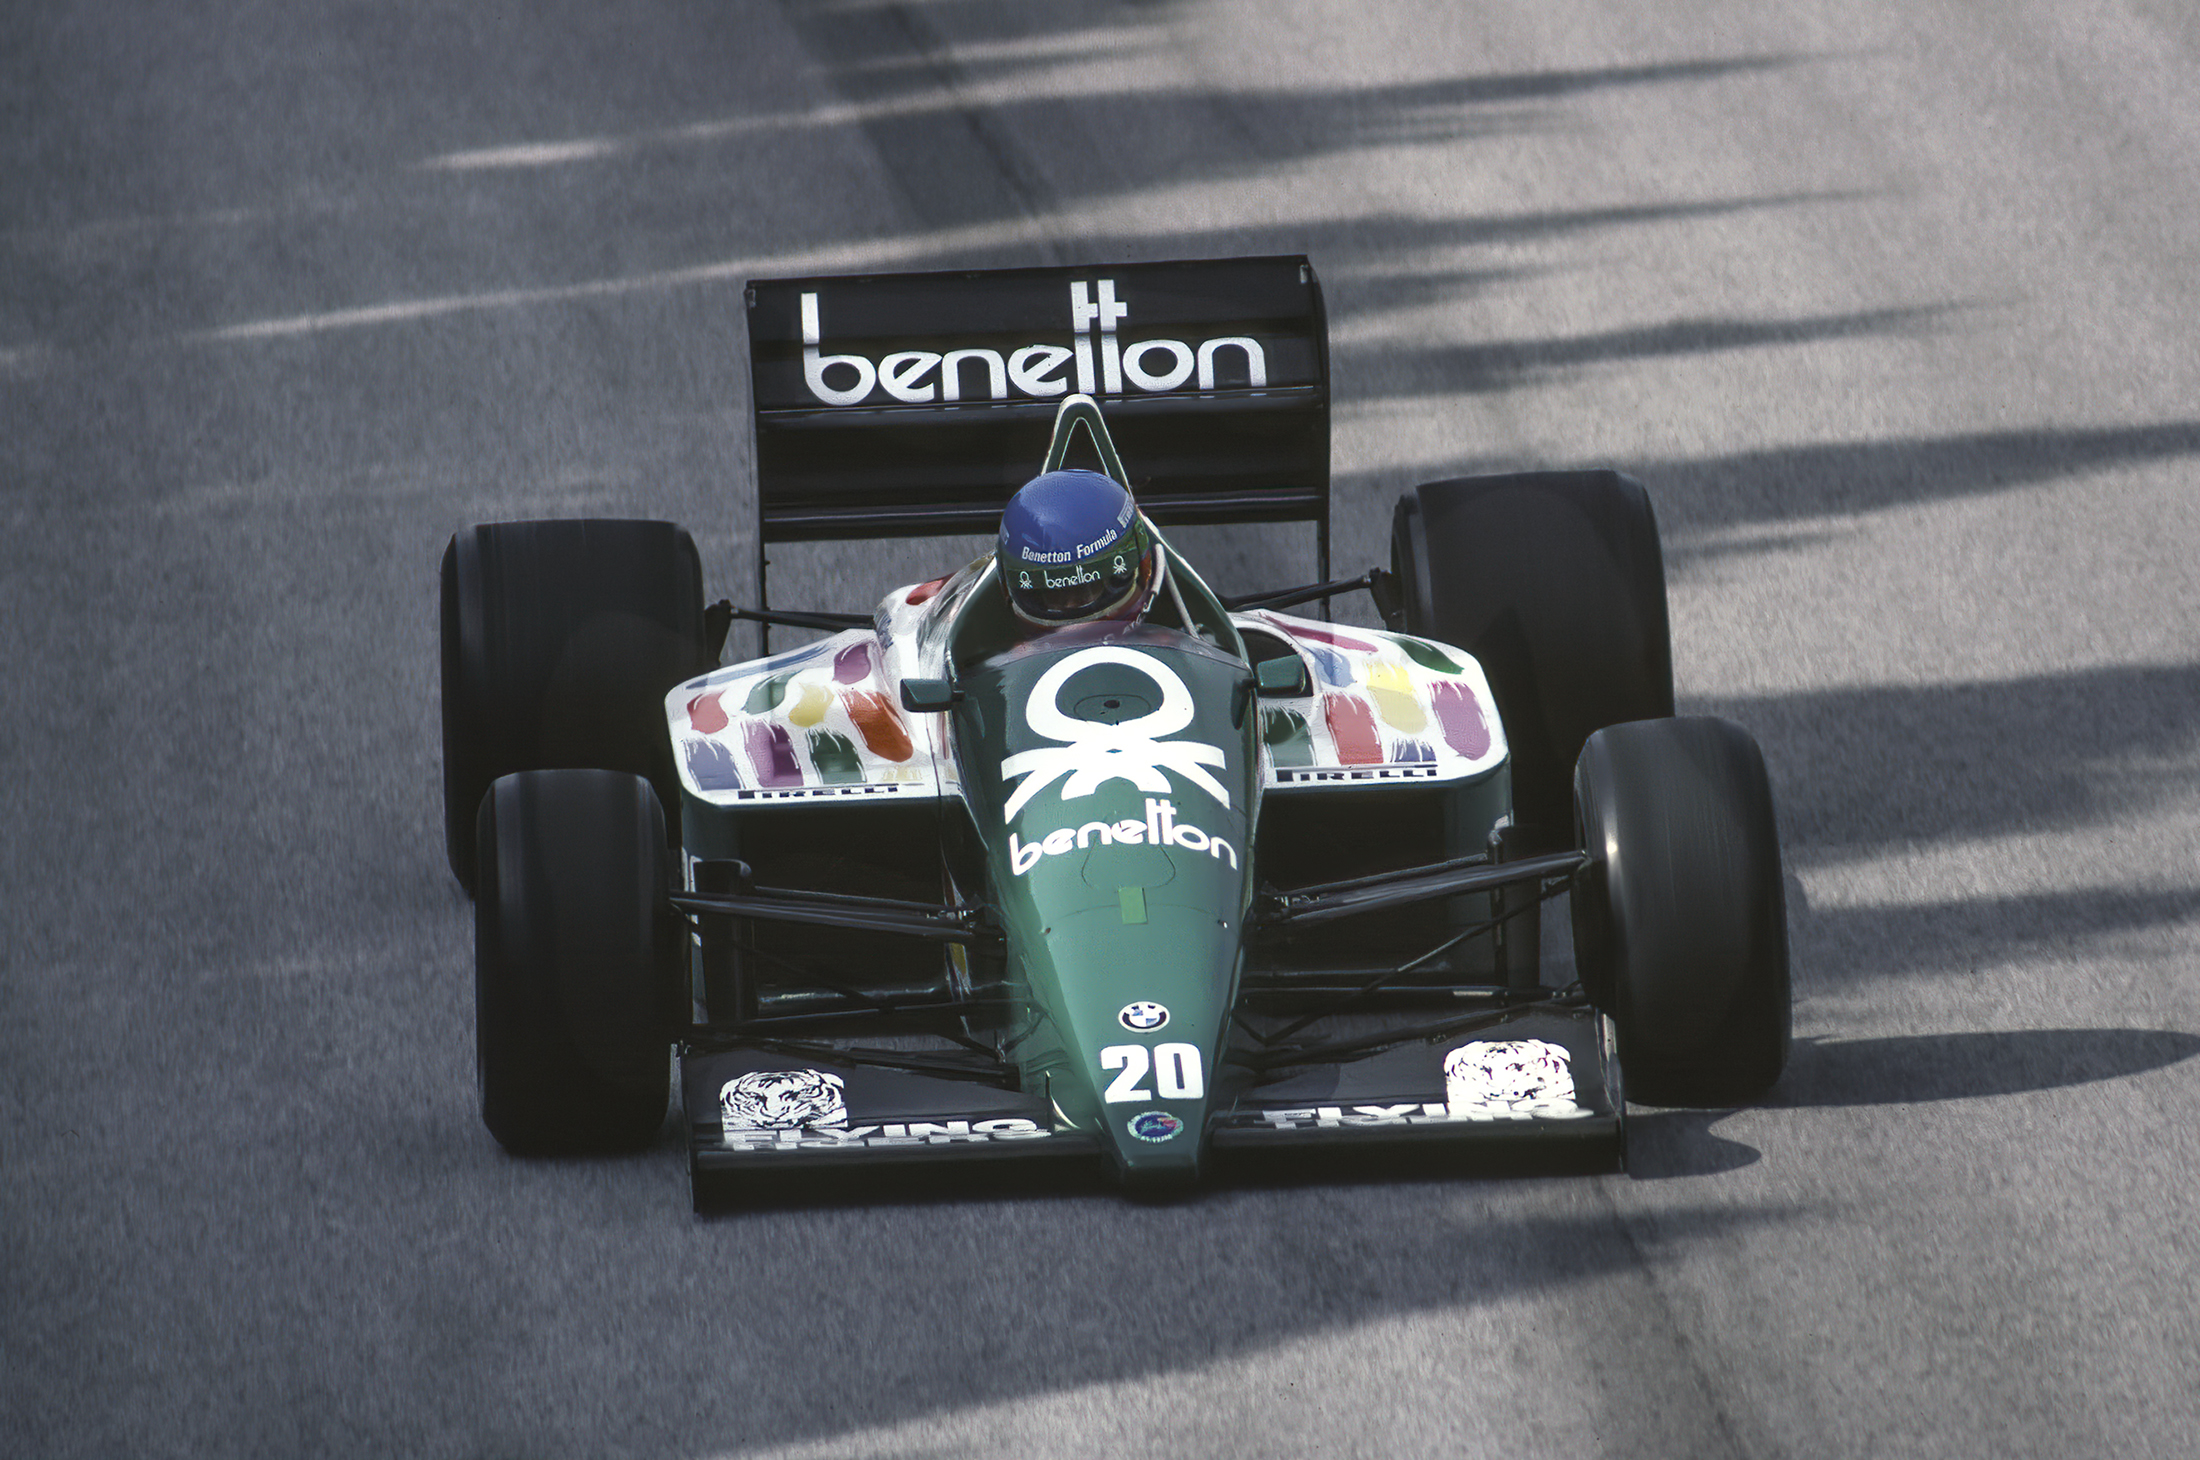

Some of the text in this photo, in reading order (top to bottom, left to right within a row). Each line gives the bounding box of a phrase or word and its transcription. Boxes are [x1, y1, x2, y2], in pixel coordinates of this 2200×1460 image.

[801, 279, 1268, 407] benetton
[1021, 527, 1119, 564] Benetton Formula
[1043, 564, 1101, 589] benetton
[1009, 798, 1238, 877] benetton
[1100, 1042, 1204, 1104] 20
